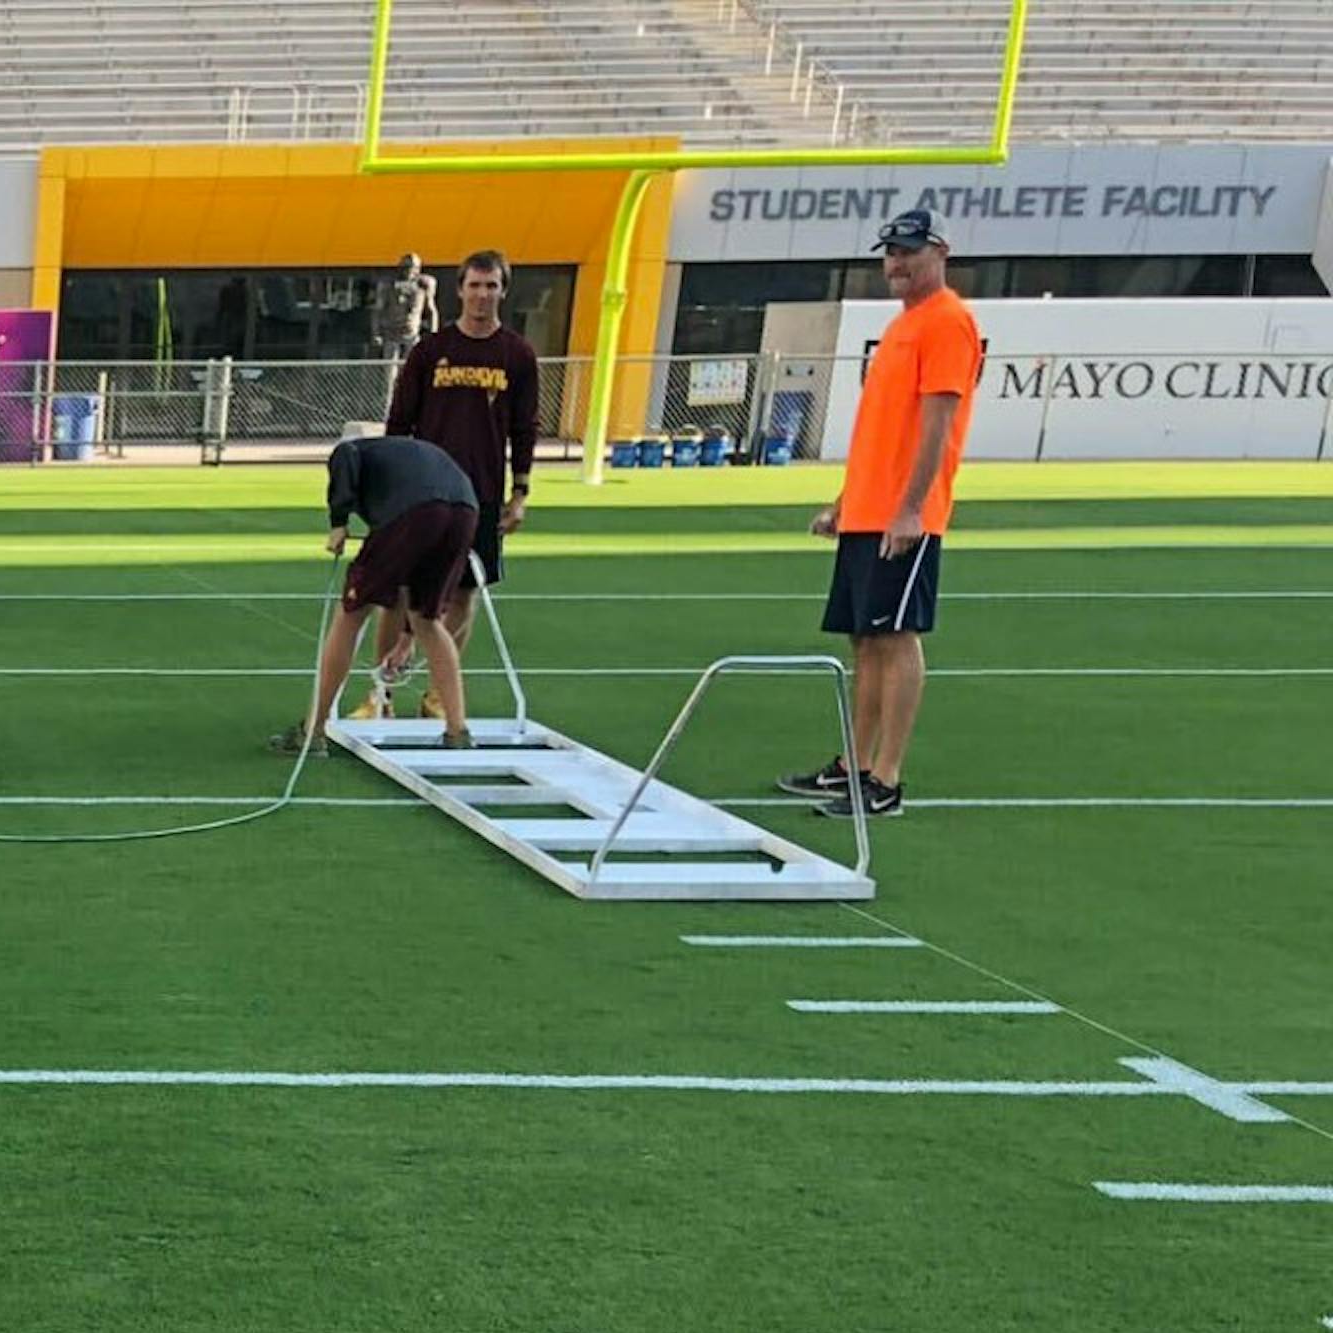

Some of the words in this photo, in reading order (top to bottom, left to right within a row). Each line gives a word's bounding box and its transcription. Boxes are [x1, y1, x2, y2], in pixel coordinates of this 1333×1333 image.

[709, 187, 900, 222] STUDENT
[913, 187, 1085, 217] ATHLETE
[1100, 186, 1277, 216] FACILITY
[998, 361, 1154, 399] MAYO
